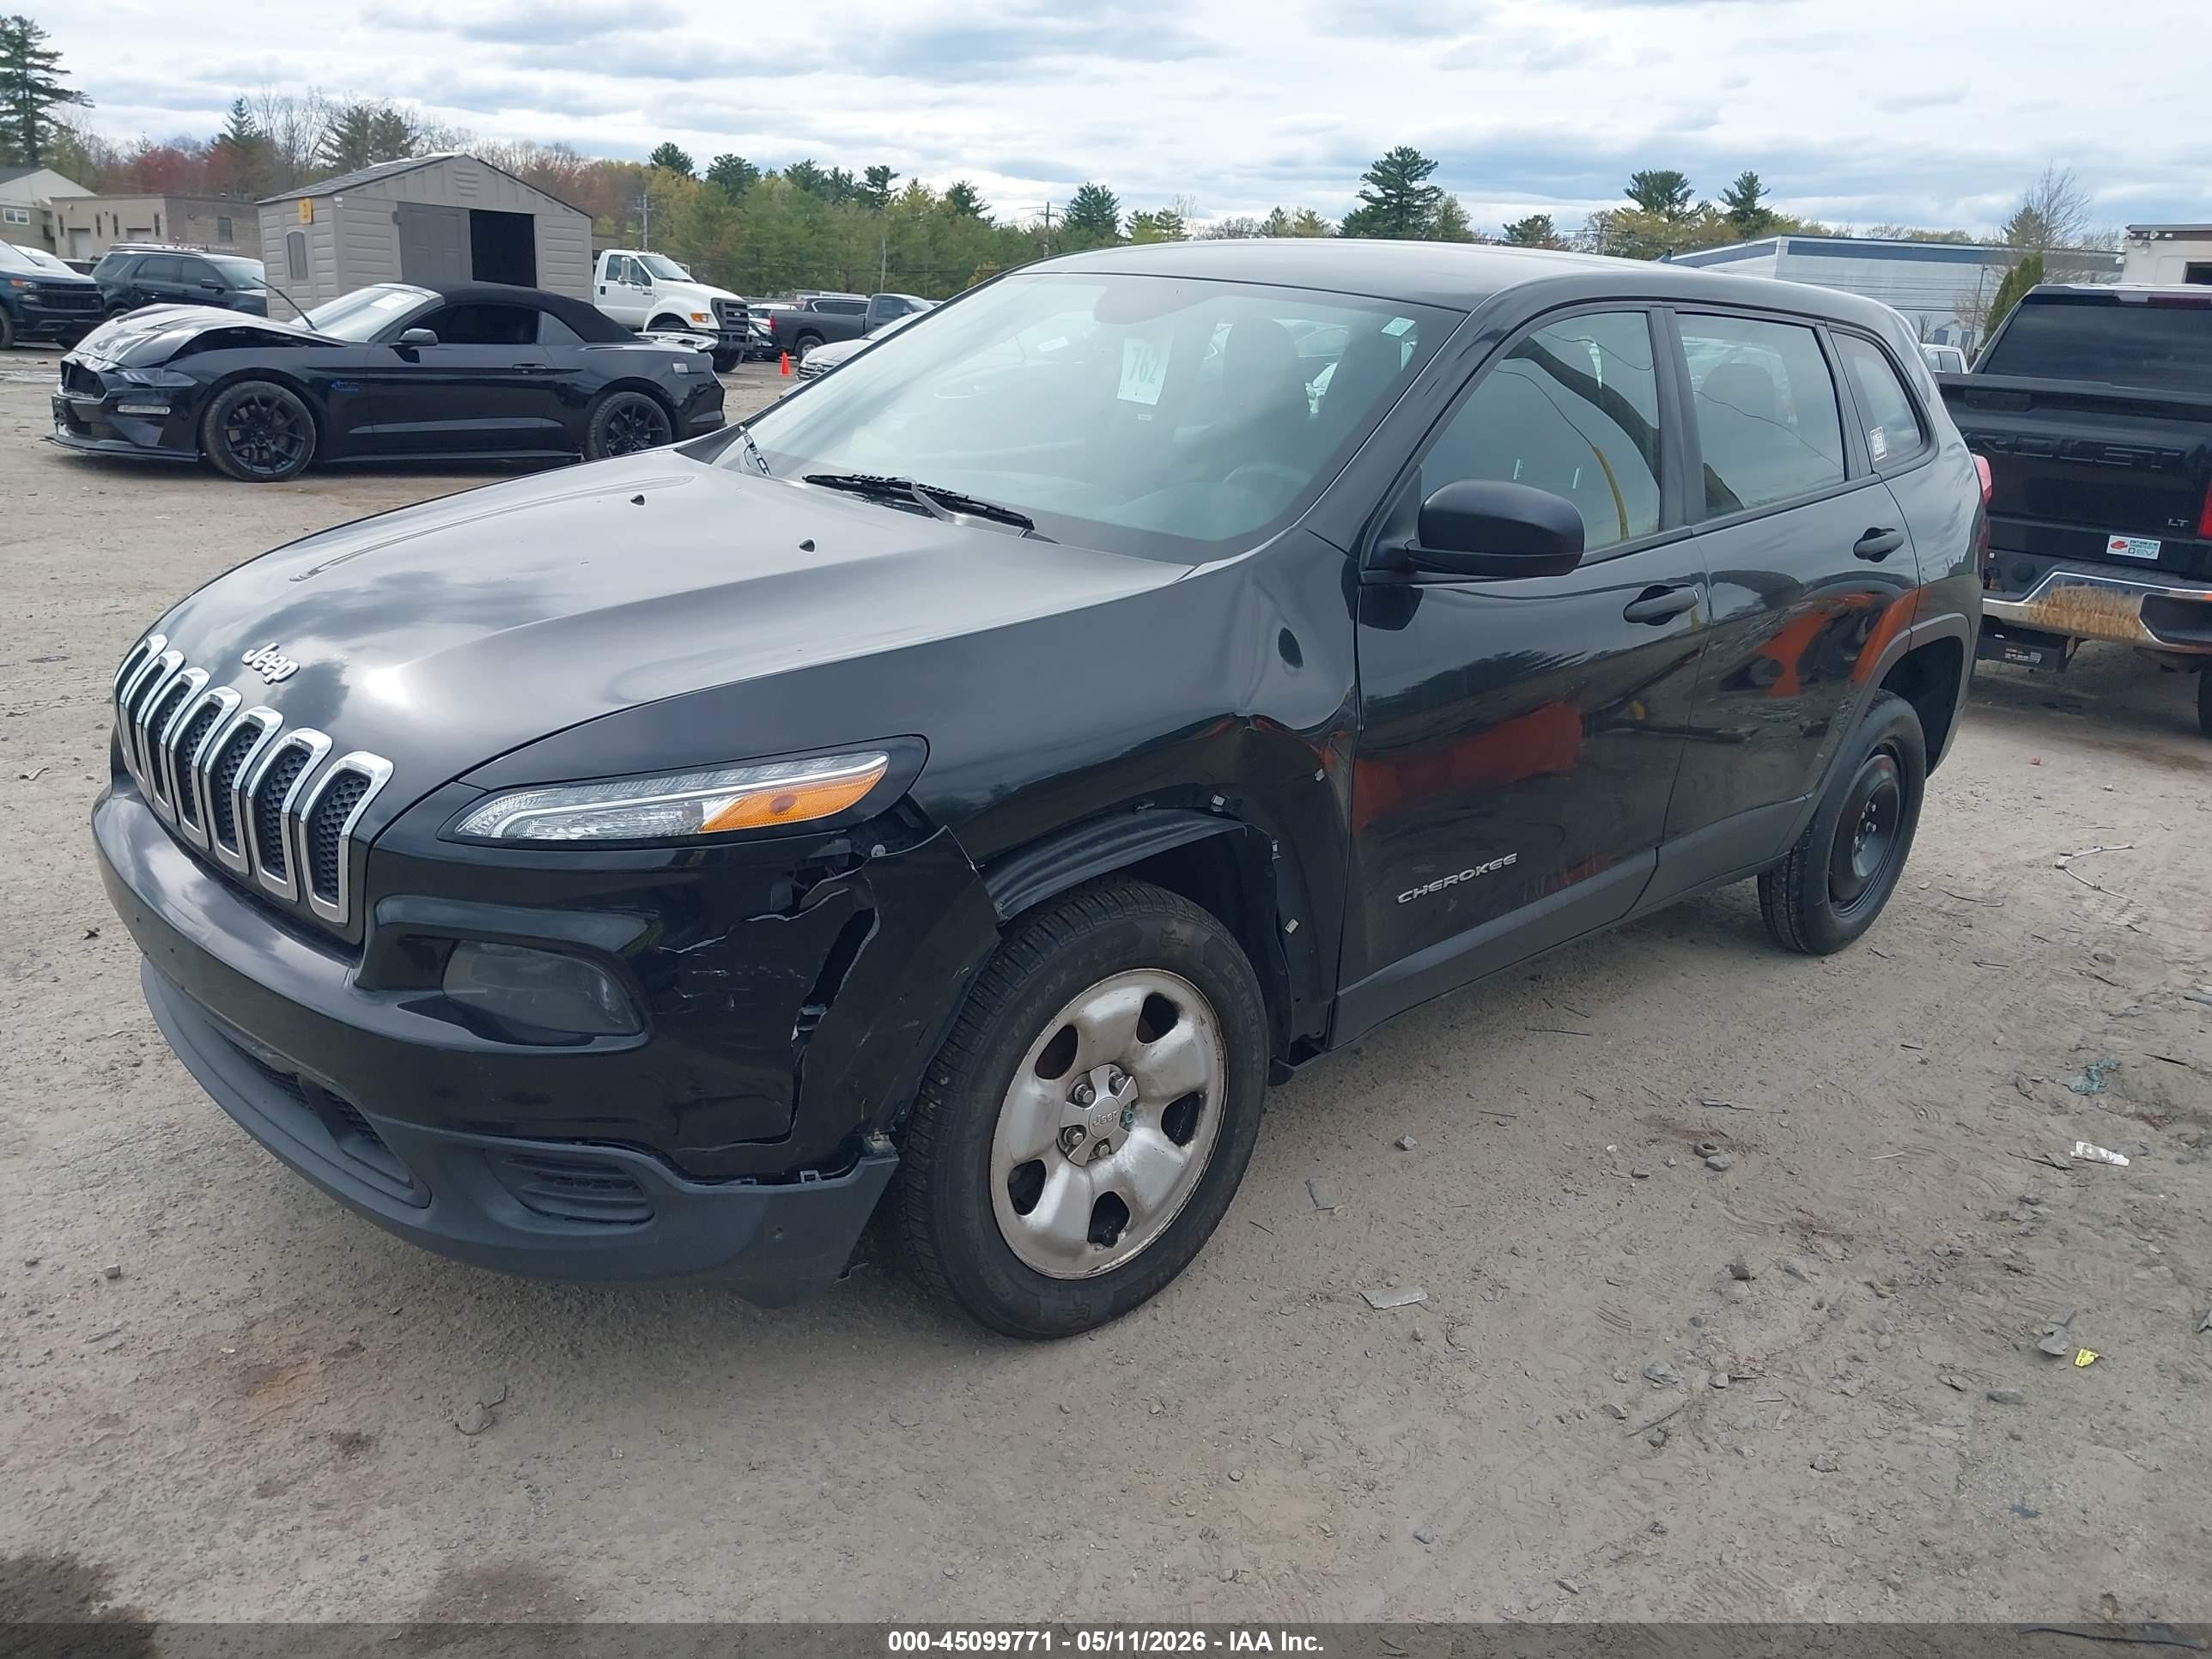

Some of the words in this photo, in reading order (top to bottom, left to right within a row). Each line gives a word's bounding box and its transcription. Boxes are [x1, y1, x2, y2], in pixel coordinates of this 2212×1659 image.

[1128, 345, 1161, 385] 762
[2167, 518, 2190, 528] LT
[241, 641, 301, 685] Jeep
[1396, 852, 1518, 904] CHEROKEE
[1091, 1109, 1118, 1127] Jeep
